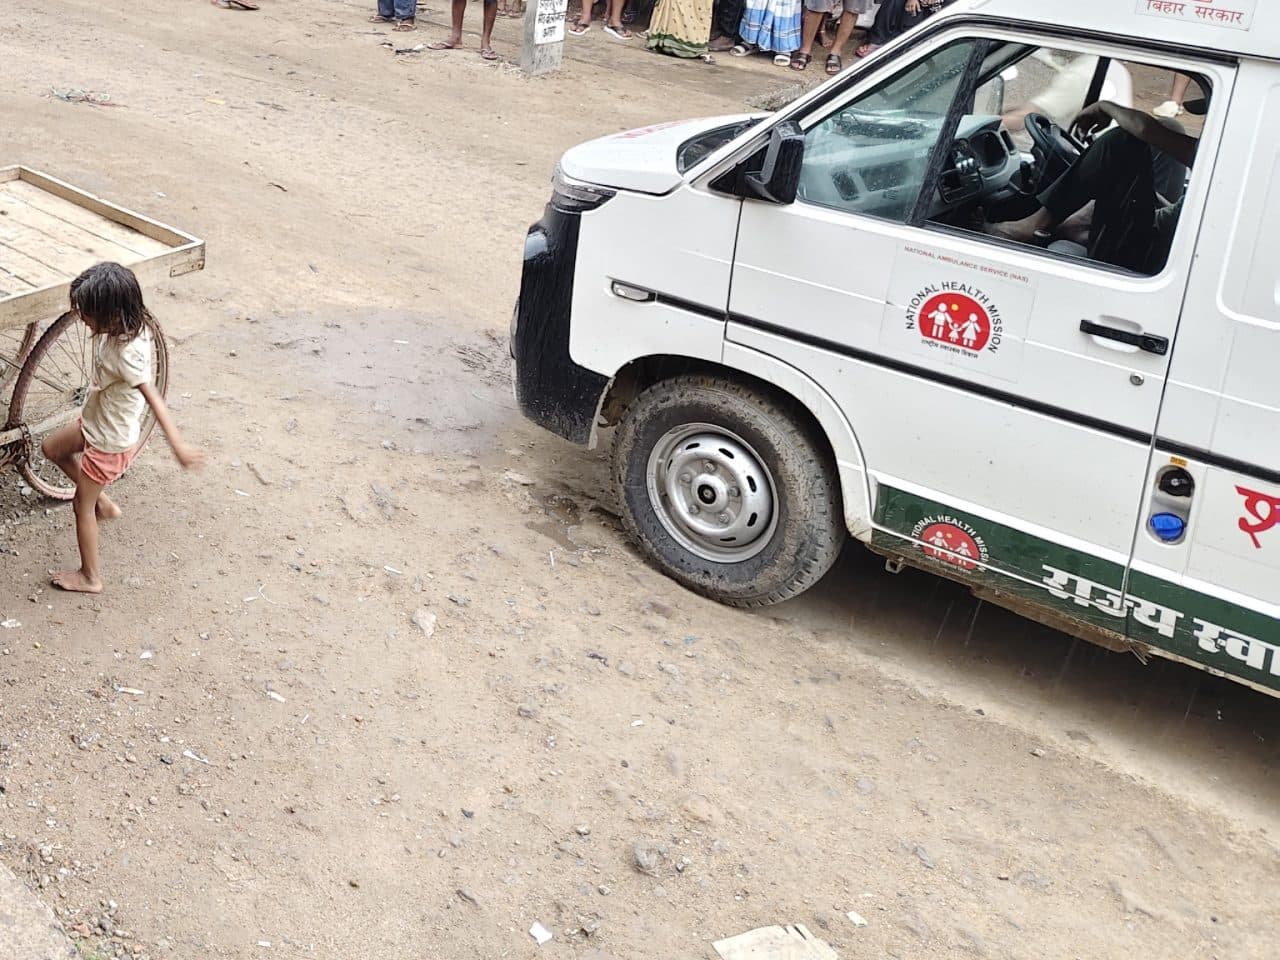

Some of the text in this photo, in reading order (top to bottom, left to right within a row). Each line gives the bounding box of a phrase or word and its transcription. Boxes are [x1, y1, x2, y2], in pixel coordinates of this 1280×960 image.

[1194, 4, 1245, 25] सरकार
[904, 246, 936, 259] NATIONAL
[937, 255, 978, 270] AMBULANCE
[980, 265, 1009, 278] SERVICE
[905, 281, 1003, 354] NATIONAL HEALTH MISSION
[937, 514, 977, 537] HEALTH
[1042, 564, 1185, 639] राज्य
